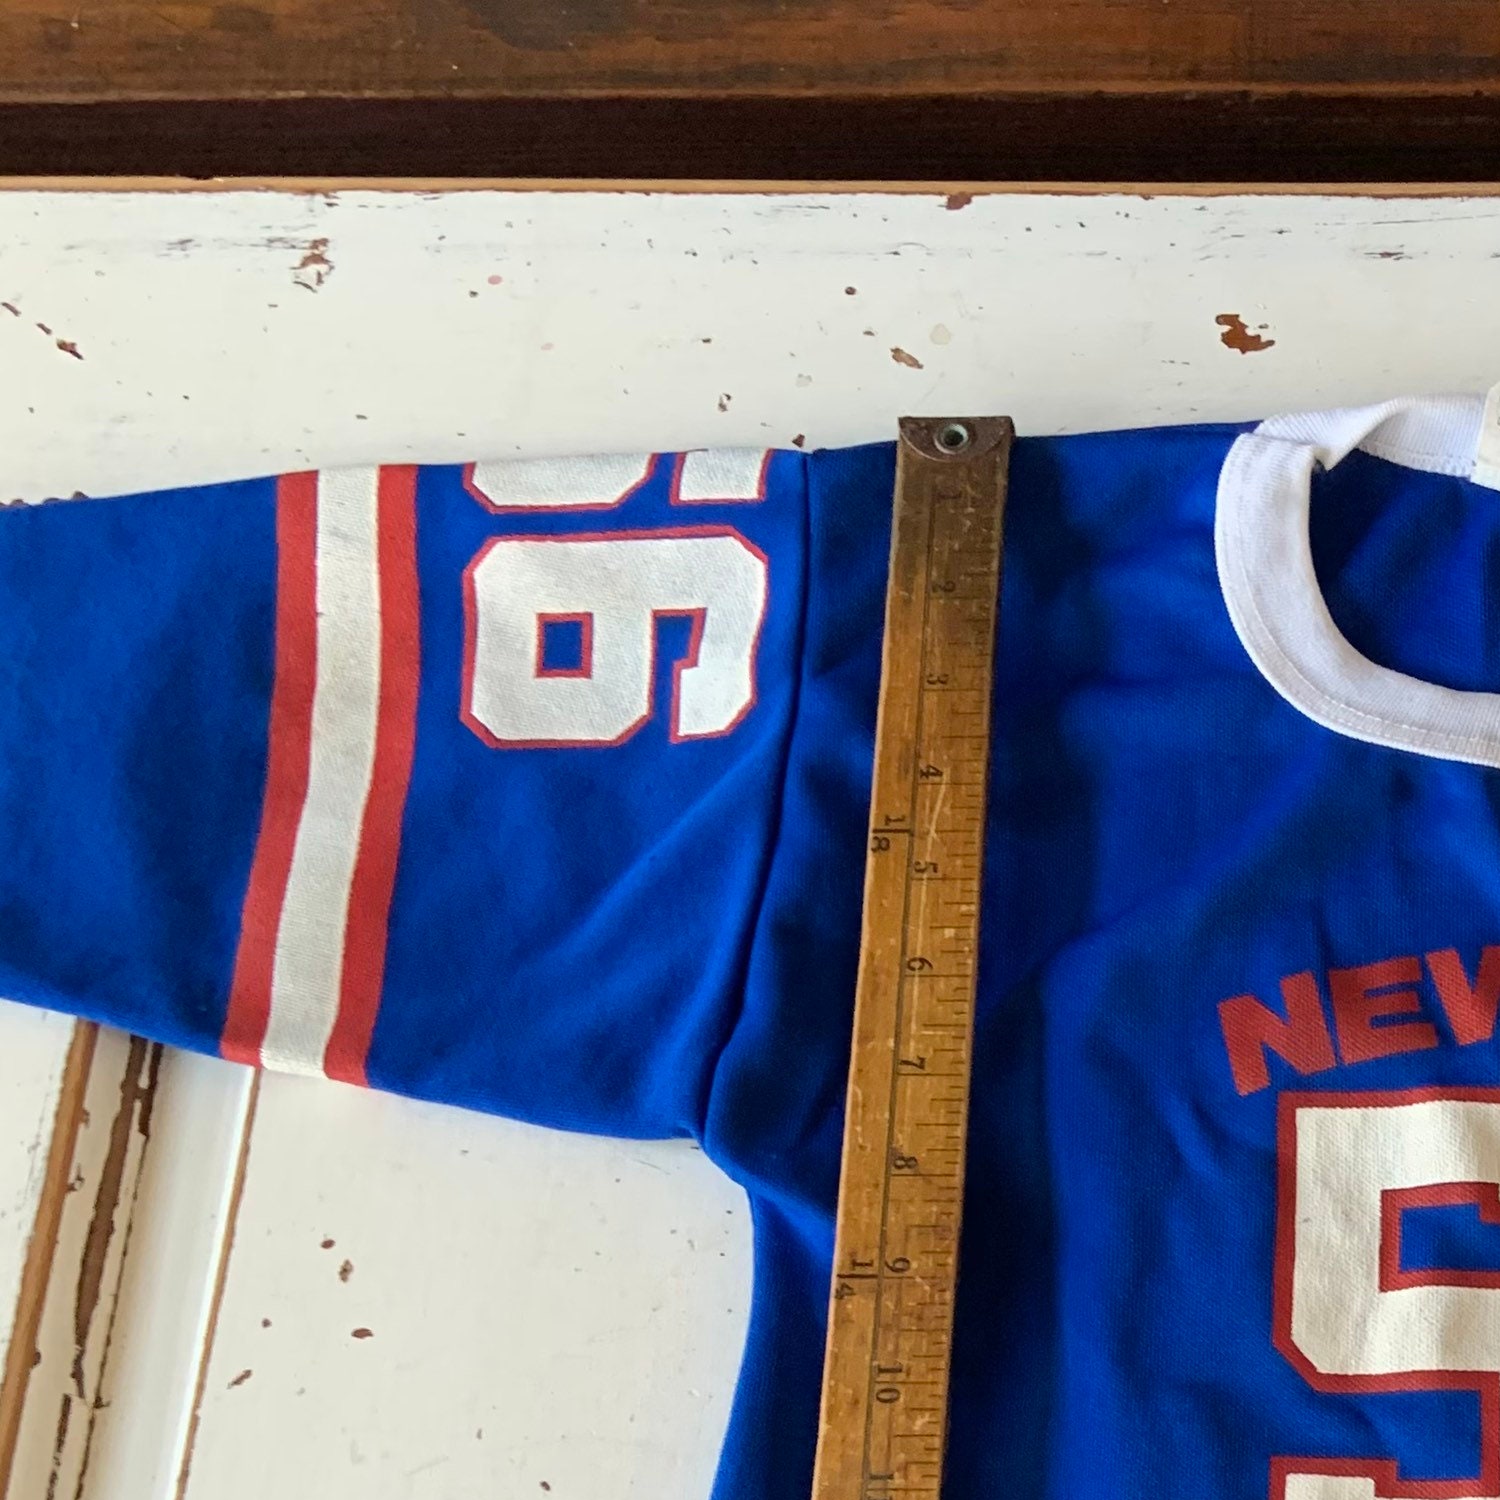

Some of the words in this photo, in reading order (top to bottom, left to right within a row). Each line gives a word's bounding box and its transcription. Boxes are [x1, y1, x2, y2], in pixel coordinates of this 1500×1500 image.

[931, 581, 955, 593] 2
[926, 673, 950, 686] 3
[919, 764, 944, 779] 4
[914, 860, 939, 875] 5
[907, 956, 933, 972] 6
[899, 1055, 926, 1071] 7
[892, 1155, 918, 1171] 8
[884, 1257, 911, 1273] 9
